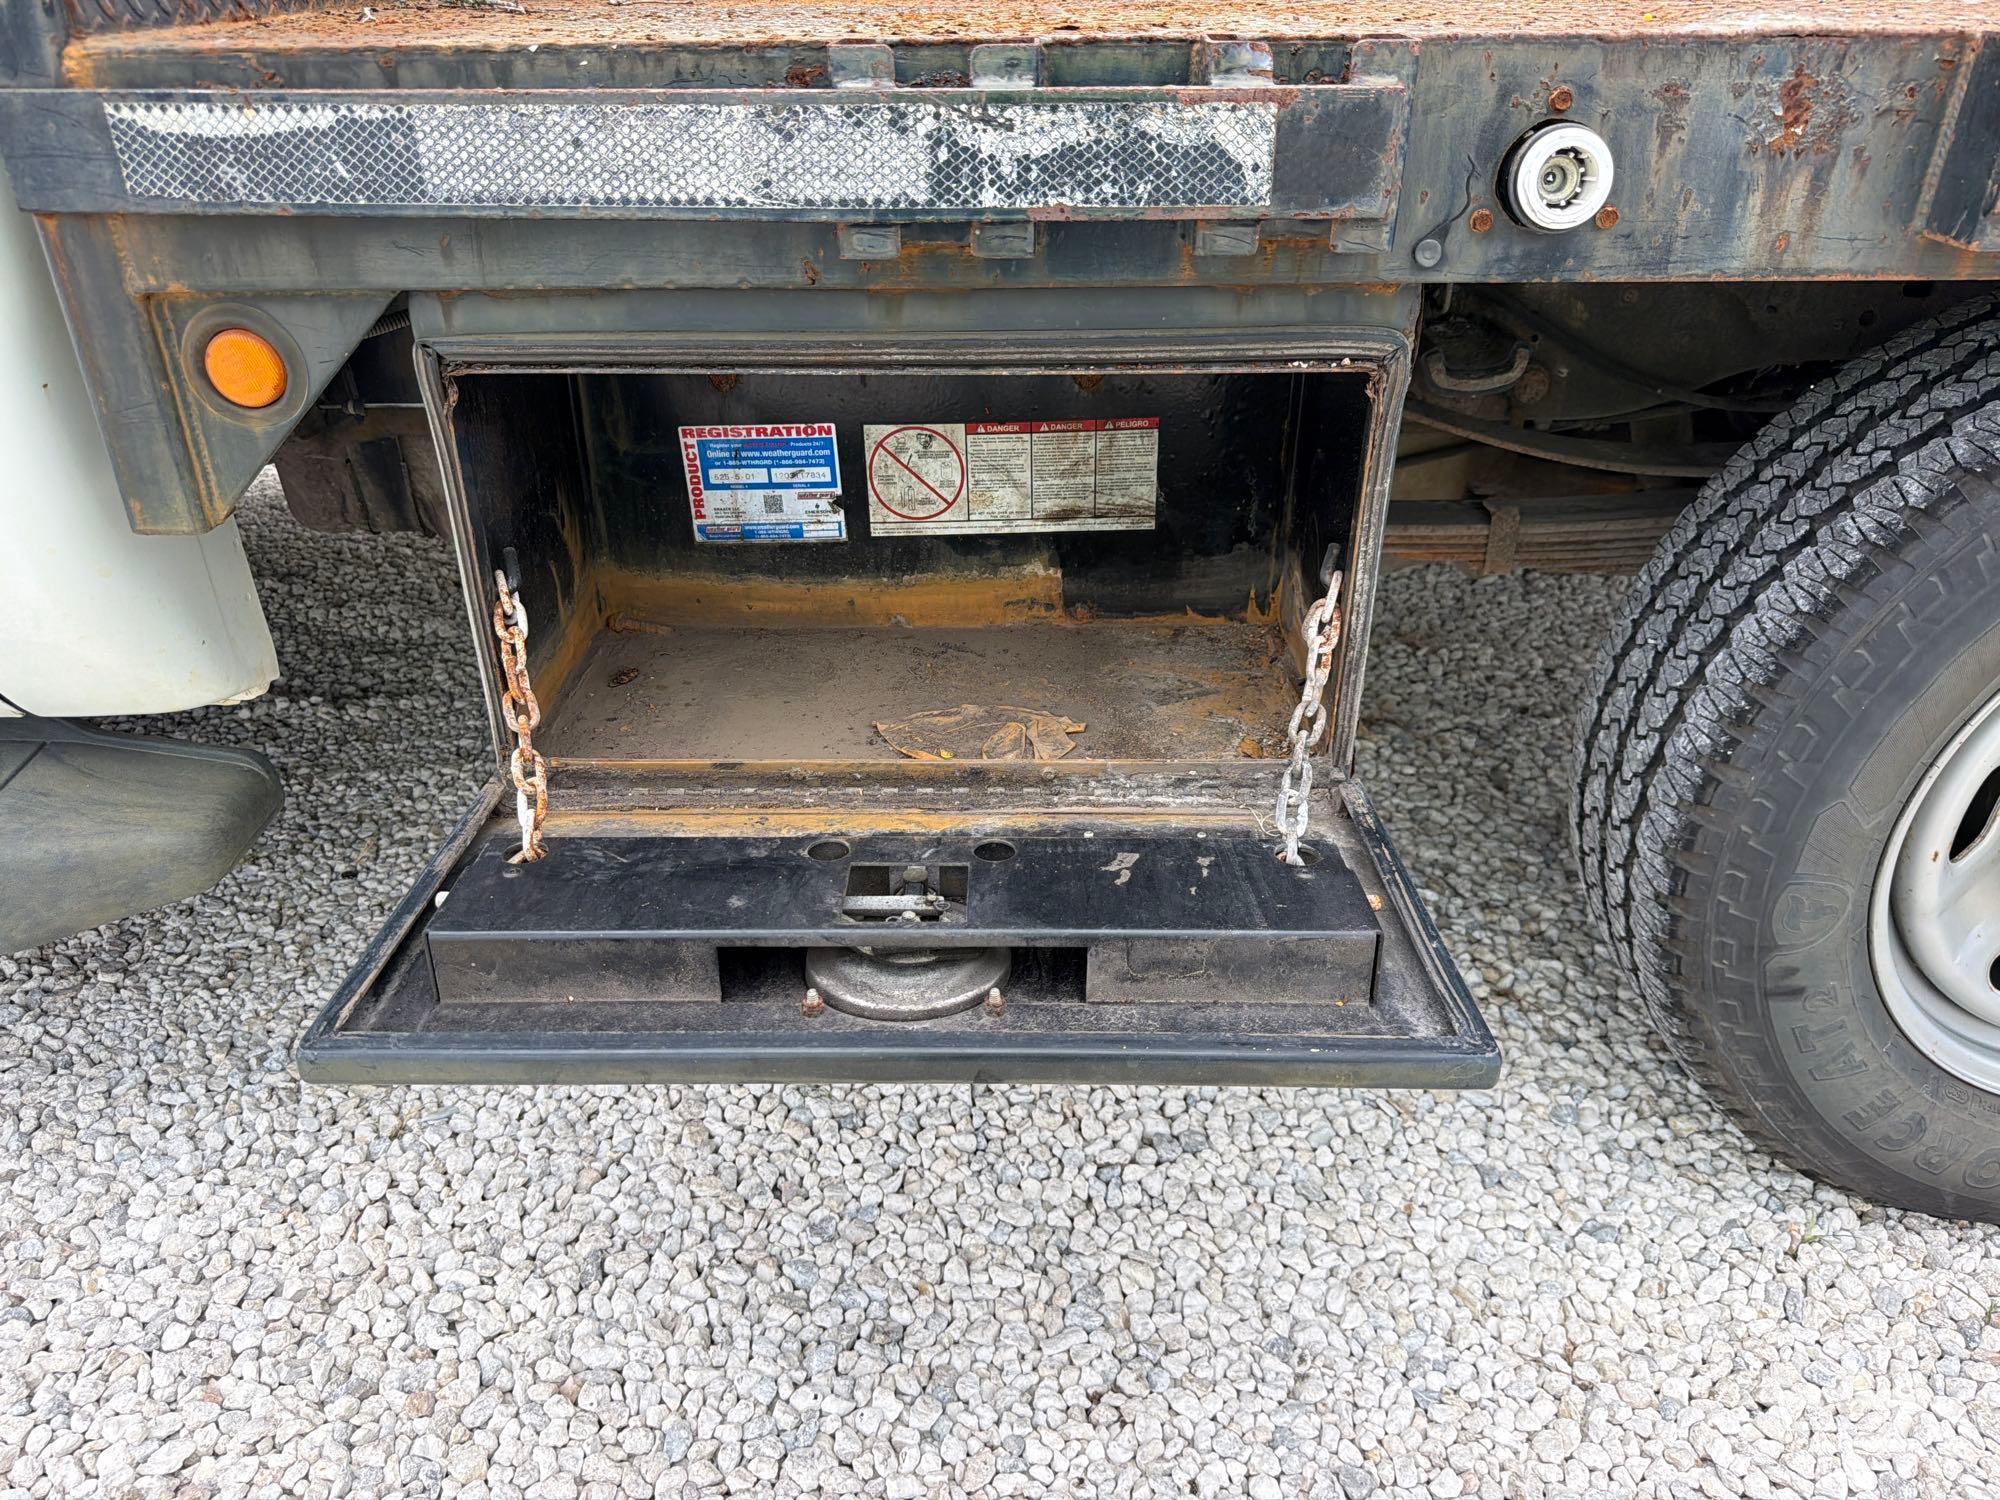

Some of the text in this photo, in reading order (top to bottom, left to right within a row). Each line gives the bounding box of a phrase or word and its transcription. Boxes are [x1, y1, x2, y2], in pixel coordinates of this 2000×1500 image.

[987, 424, 1020, 432] DANGER
[1051, 422, 1083, 431] DANGER
[1116, 419, 1149, 428] PELIGRO
[681, 424, 833, 439] REGISTRATION
[741, 448, 831, 458] www.weatherguard.com
[683, 441, 707, 520] PRODUCT
